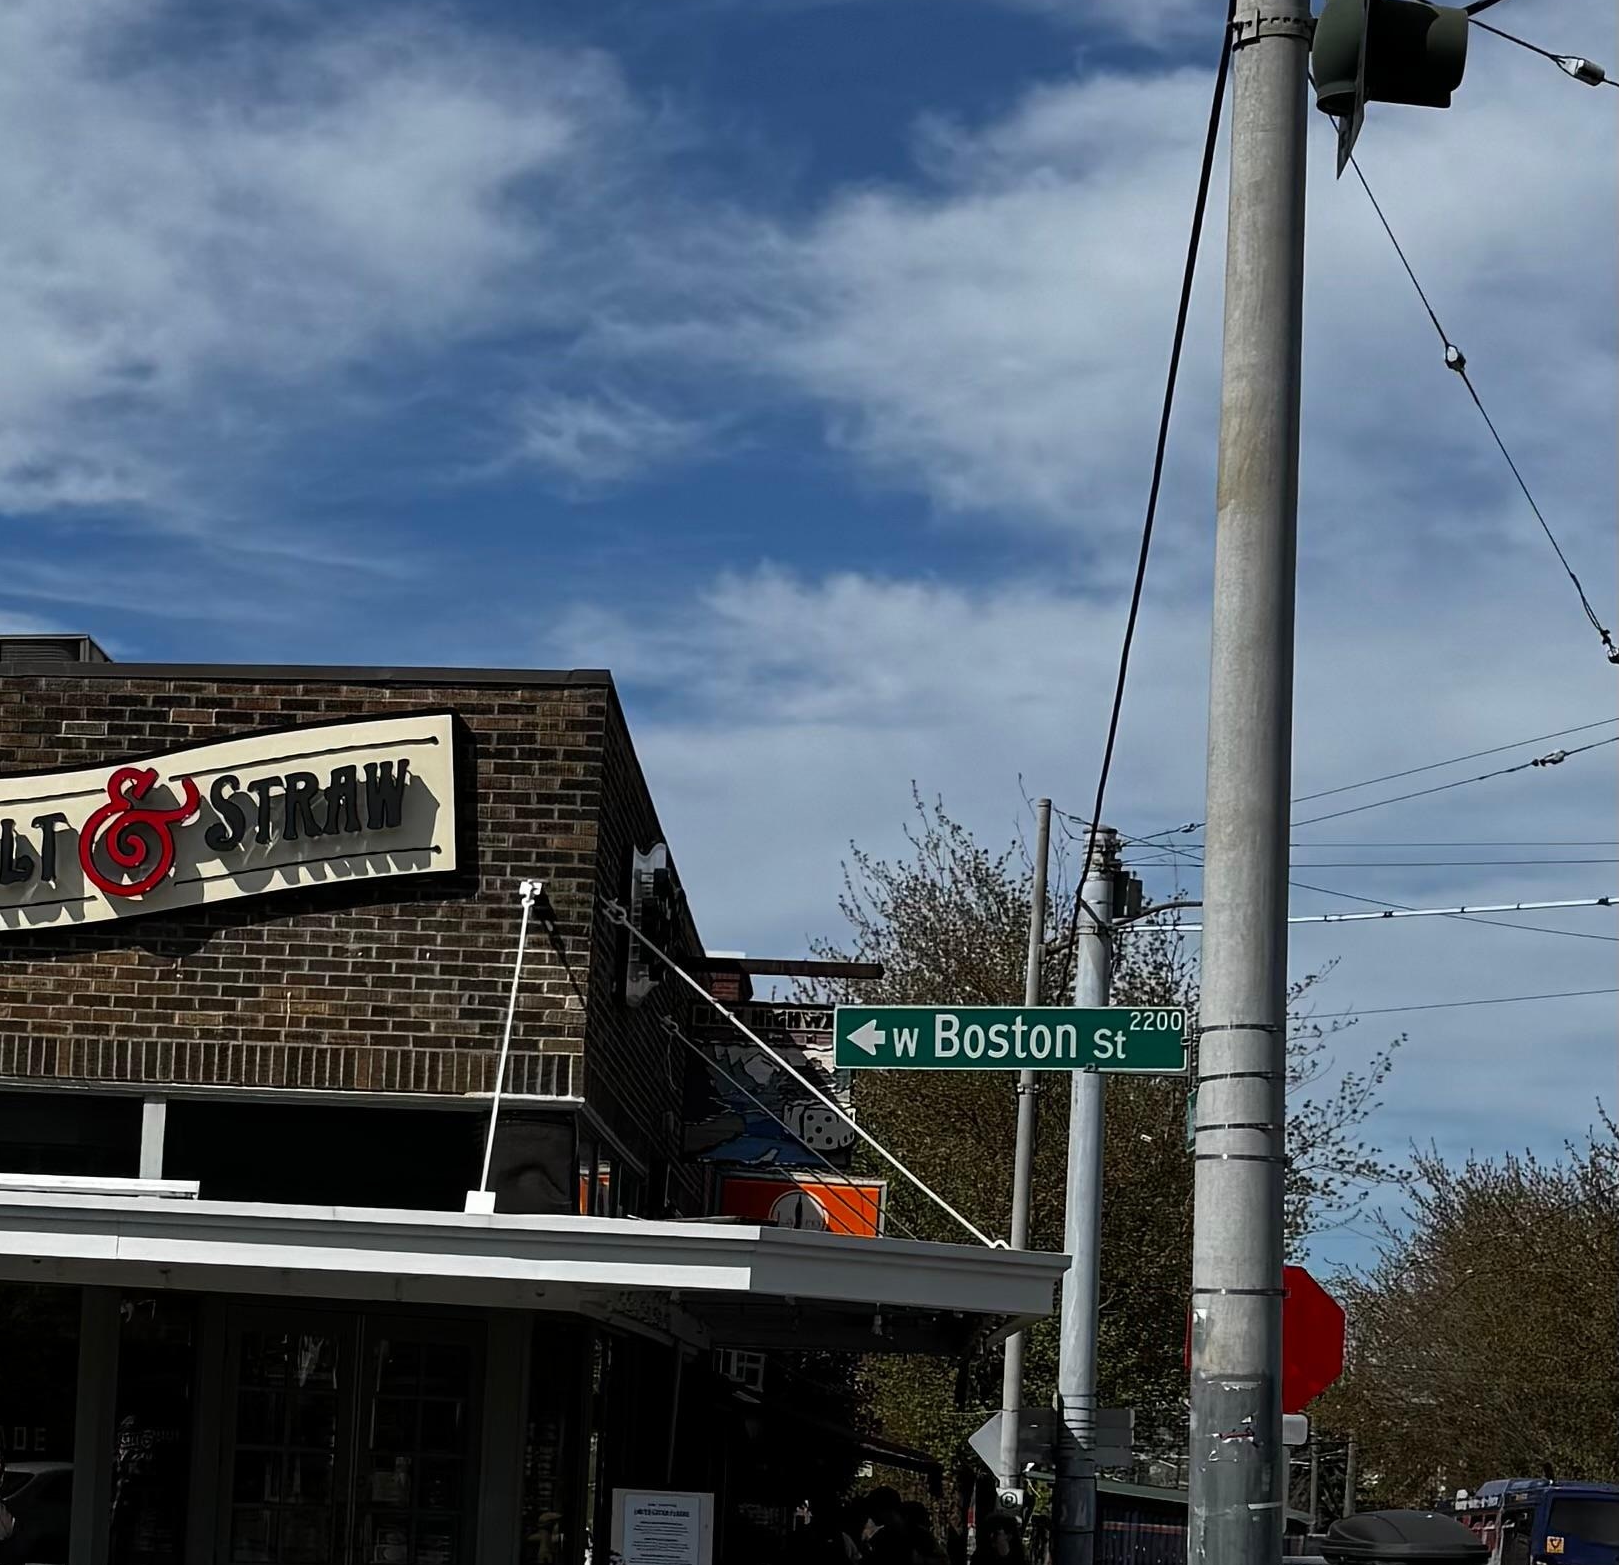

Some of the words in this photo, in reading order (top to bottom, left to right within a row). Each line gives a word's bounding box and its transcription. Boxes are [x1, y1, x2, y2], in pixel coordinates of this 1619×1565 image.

[79, 766, 203, 899] &
[205, 758, 412, 852] STRAW
[892, 1027, 920, 1059] W
[934, 1013, 1078, 1060] Boston
[1092, 1028, 1127, 1060] St
[1130, 1011, 1182, 1032] 2200
